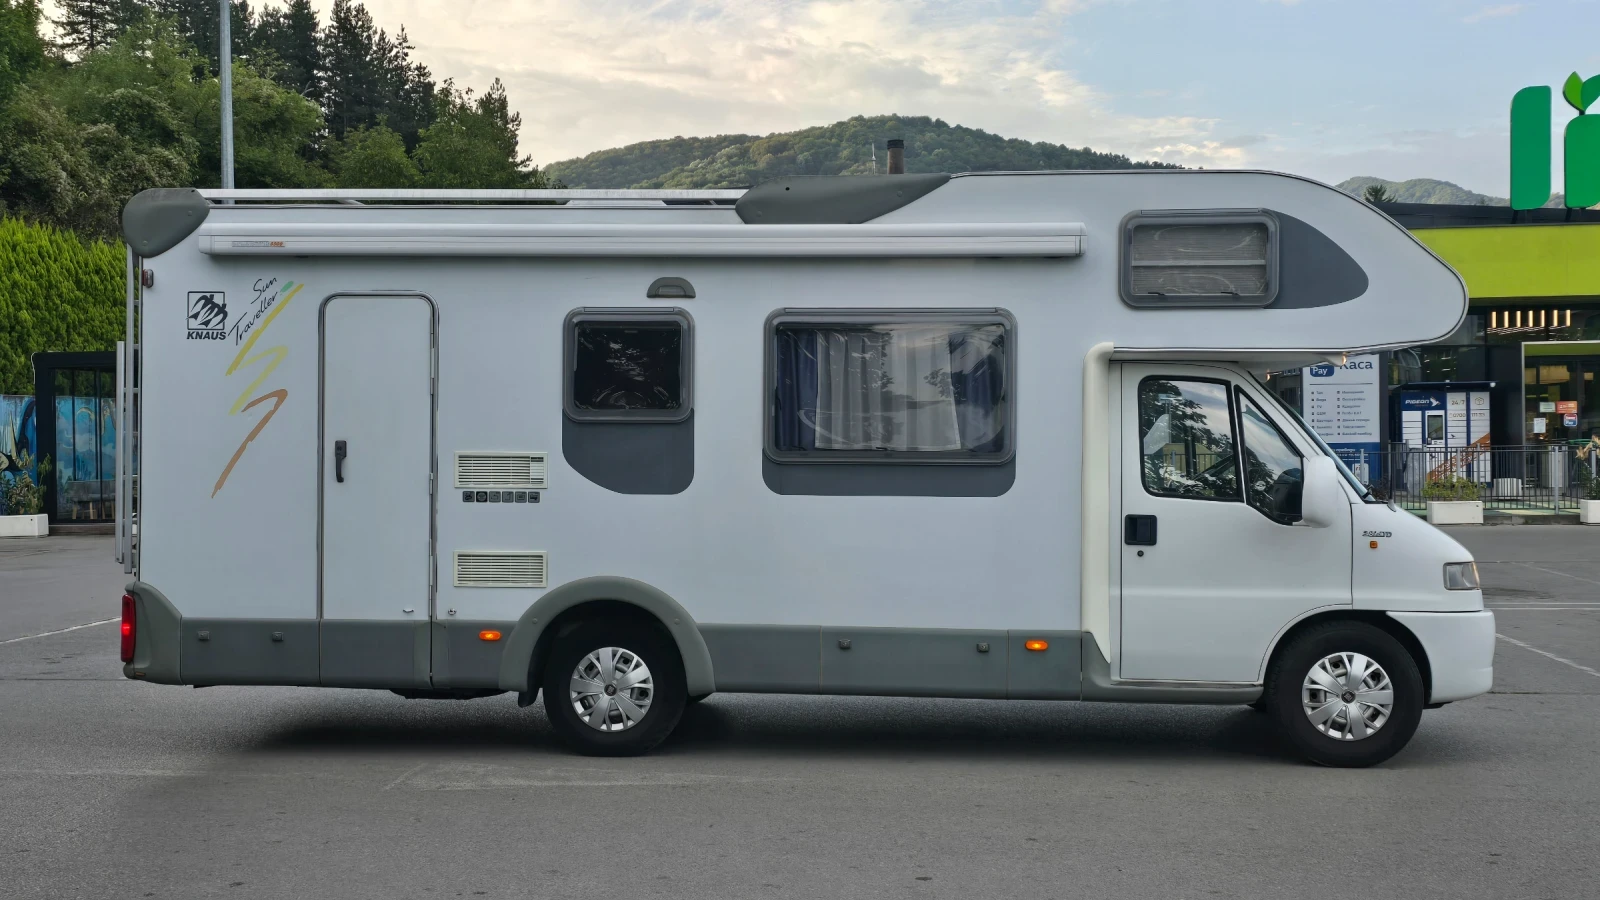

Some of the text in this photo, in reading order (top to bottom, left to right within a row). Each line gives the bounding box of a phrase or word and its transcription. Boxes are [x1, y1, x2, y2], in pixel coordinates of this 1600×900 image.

[250, 277, 277, 304] Sun
[227, 291, 278, 346] Traveller
[186, 331, 226, 340] KNAUS
[1312, 366, 1328, 375] Pay
